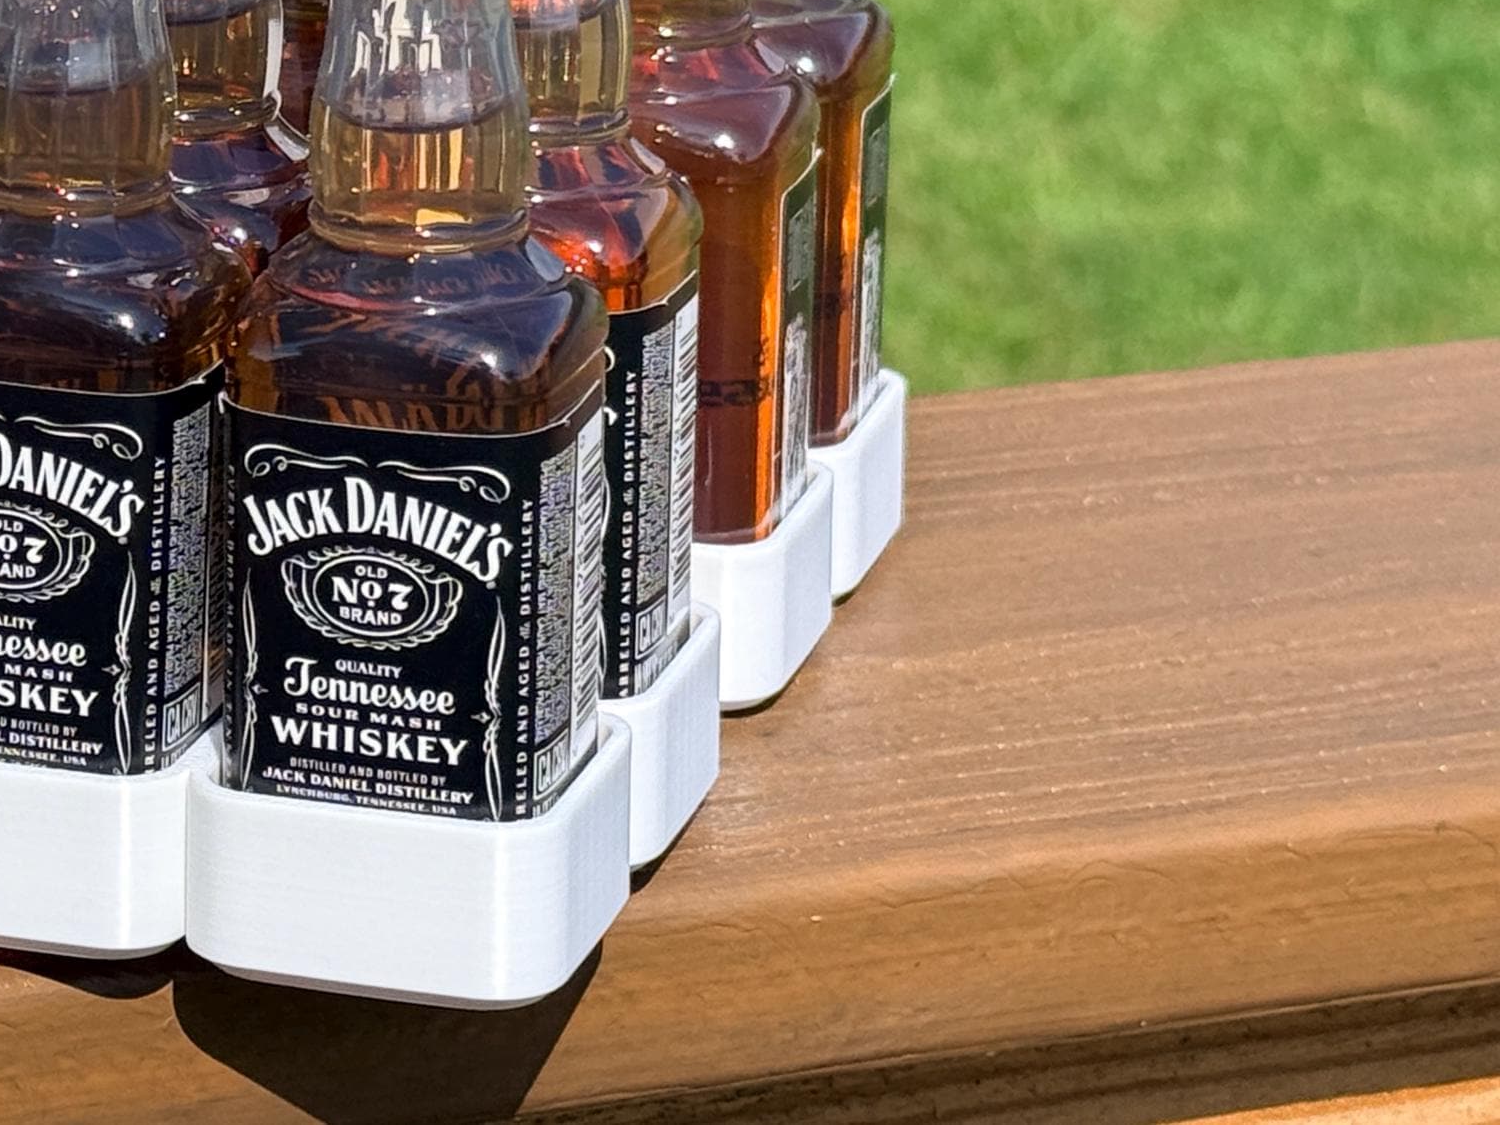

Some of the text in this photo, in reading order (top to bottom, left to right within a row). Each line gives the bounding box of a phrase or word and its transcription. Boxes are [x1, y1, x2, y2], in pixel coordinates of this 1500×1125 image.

[623, 371, 637, 481] DISTILLERY
[150, 457, 166, 570] DISTILLERY
[244, 476, 513, 582] JACK DANIEL'S
[622, 511, 633, 560] AGED
[355, 565, 387, 579] OLD
[520, 500, 533, 615] DISTILLERY
[621, 568, 632, 605] AND
[149, 601, 161, 651] AGED
[340, 606, 402, 626] BRAND
[4, 664, 73, 682] MASH
[147, 659, 159, 696] AND
[284, 658, 455, 714] Tennessee
[336, 660, 402, 678] QUALITY
[518, 646, 531, 697] AGED
[11, 719, 59, 735] BOTTLED
[63, 727, 77, 737] BY
[296, 703, 441, 731] SOUR MASH
[517, 706, 529, 743] AND
[9, 732, 103, 754] DISTILLERY
[271, 716, 468, 765] WHISKEY
[263, 767, 474, 804] JACK DANIEL DISTILLERY
[290, 757, 447, 786] DISTILLED AND BOTTLED BY
